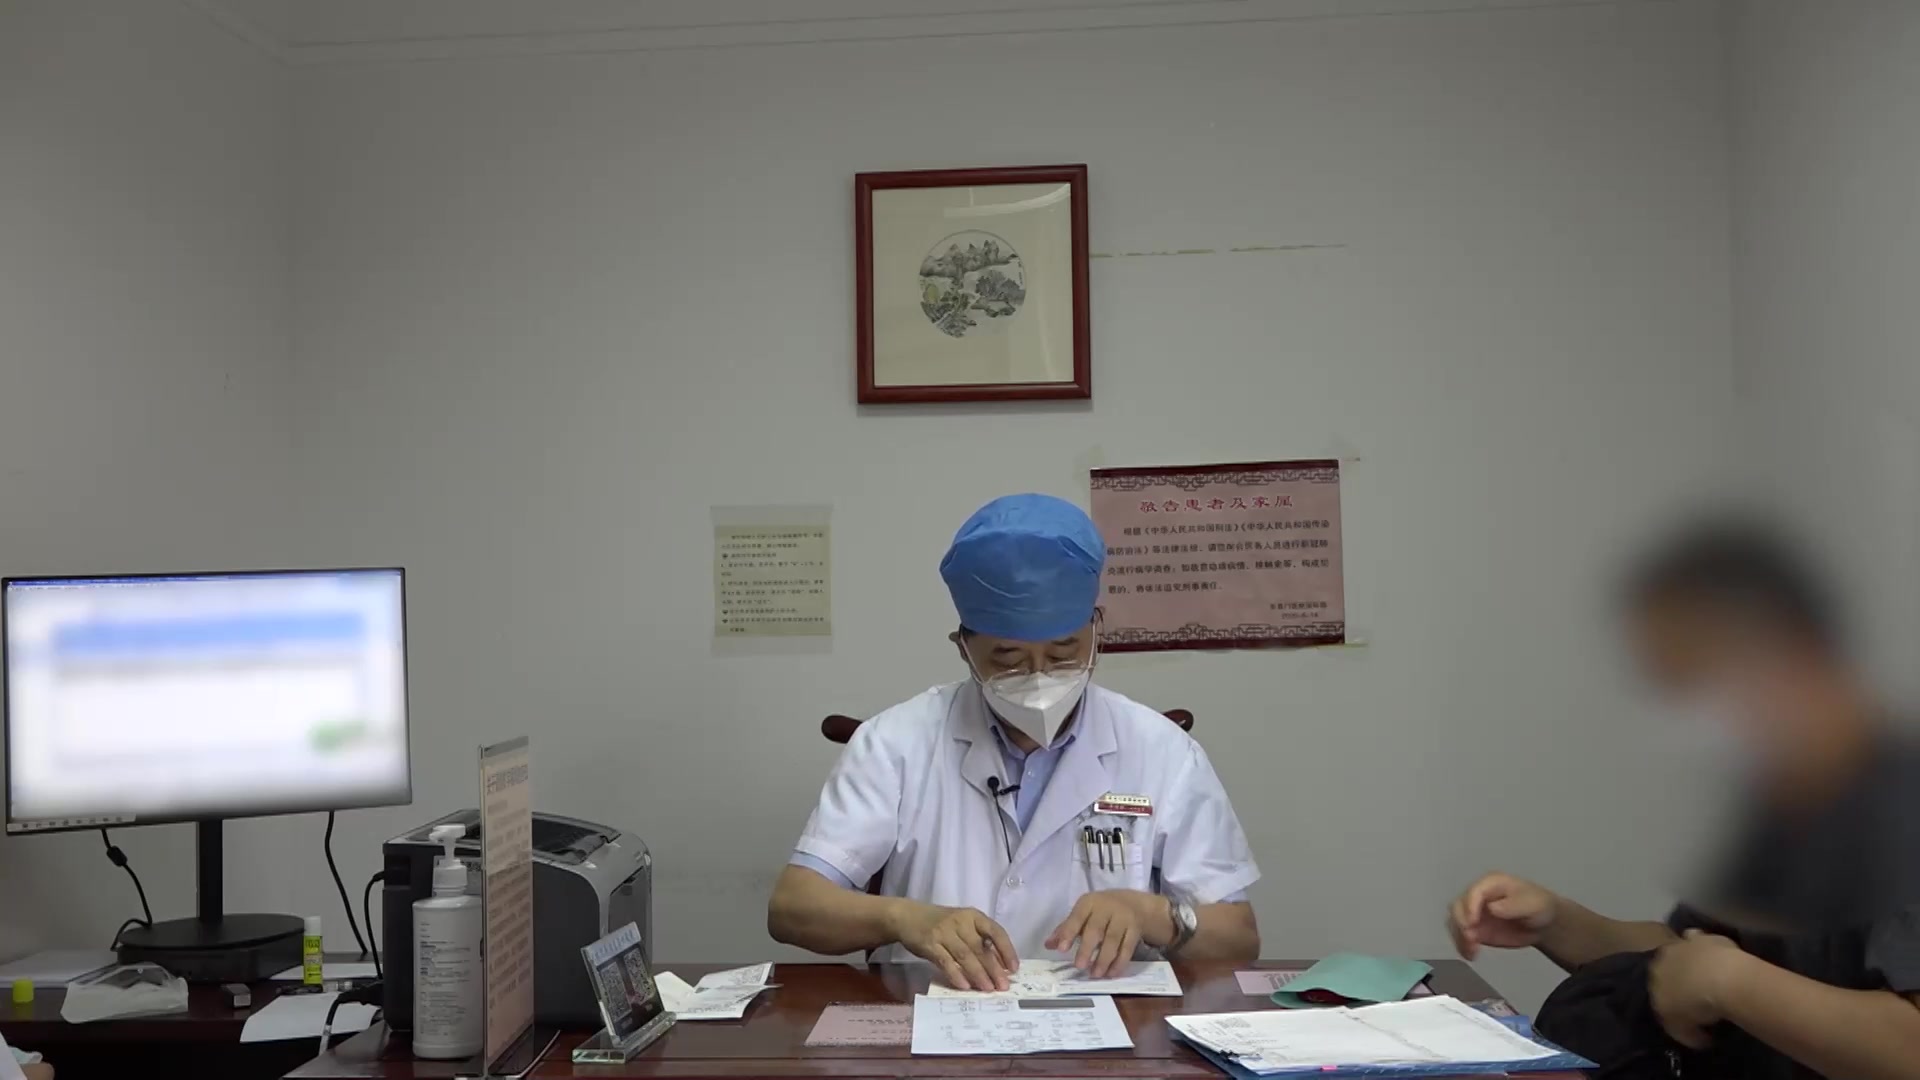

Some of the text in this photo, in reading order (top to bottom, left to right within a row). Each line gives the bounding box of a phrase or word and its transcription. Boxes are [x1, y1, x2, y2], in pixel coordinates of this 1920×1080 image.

[1139, 495, 1293, 513] 敬告患者及家属
